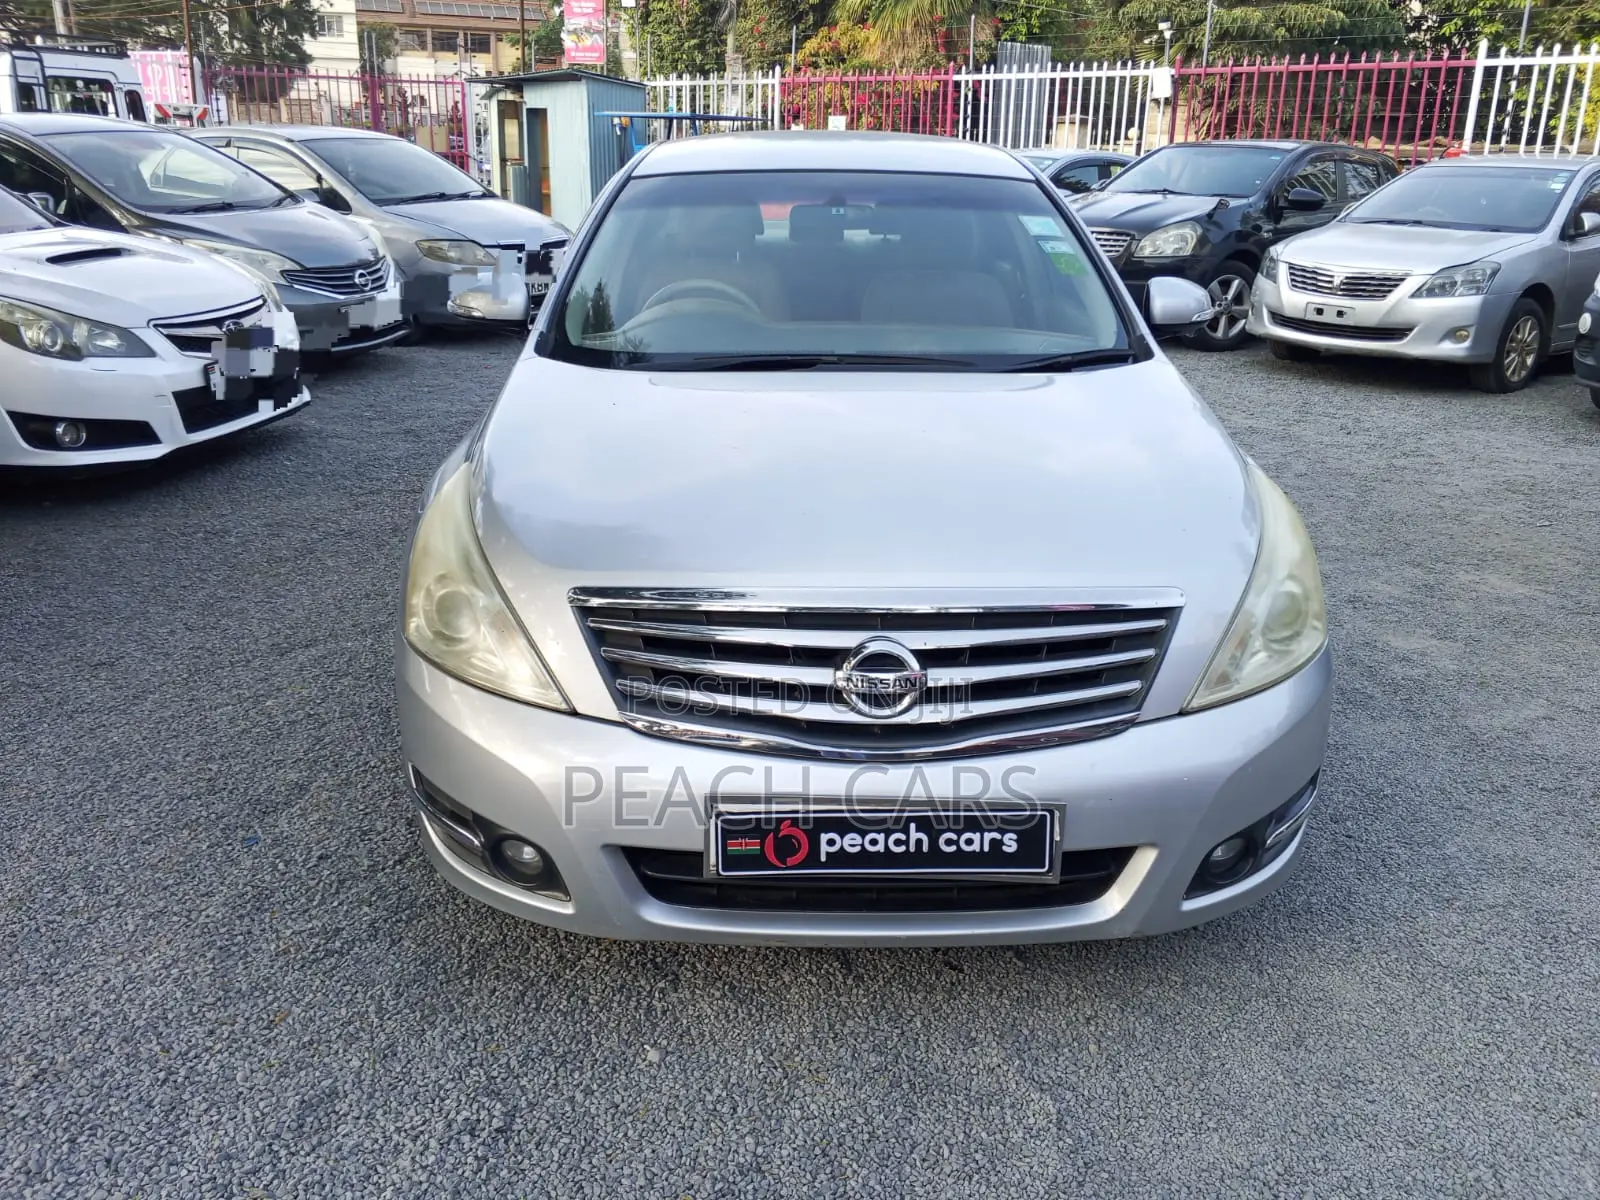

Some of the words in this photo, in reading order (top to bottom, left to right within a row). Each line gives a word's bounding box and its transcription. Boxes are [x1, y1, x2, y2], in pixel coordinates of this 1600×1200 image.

[845, 675, 918, 691] NISSAN
[819, 822, 929, 863] peach
[938, 830, 1019, 854] cars
